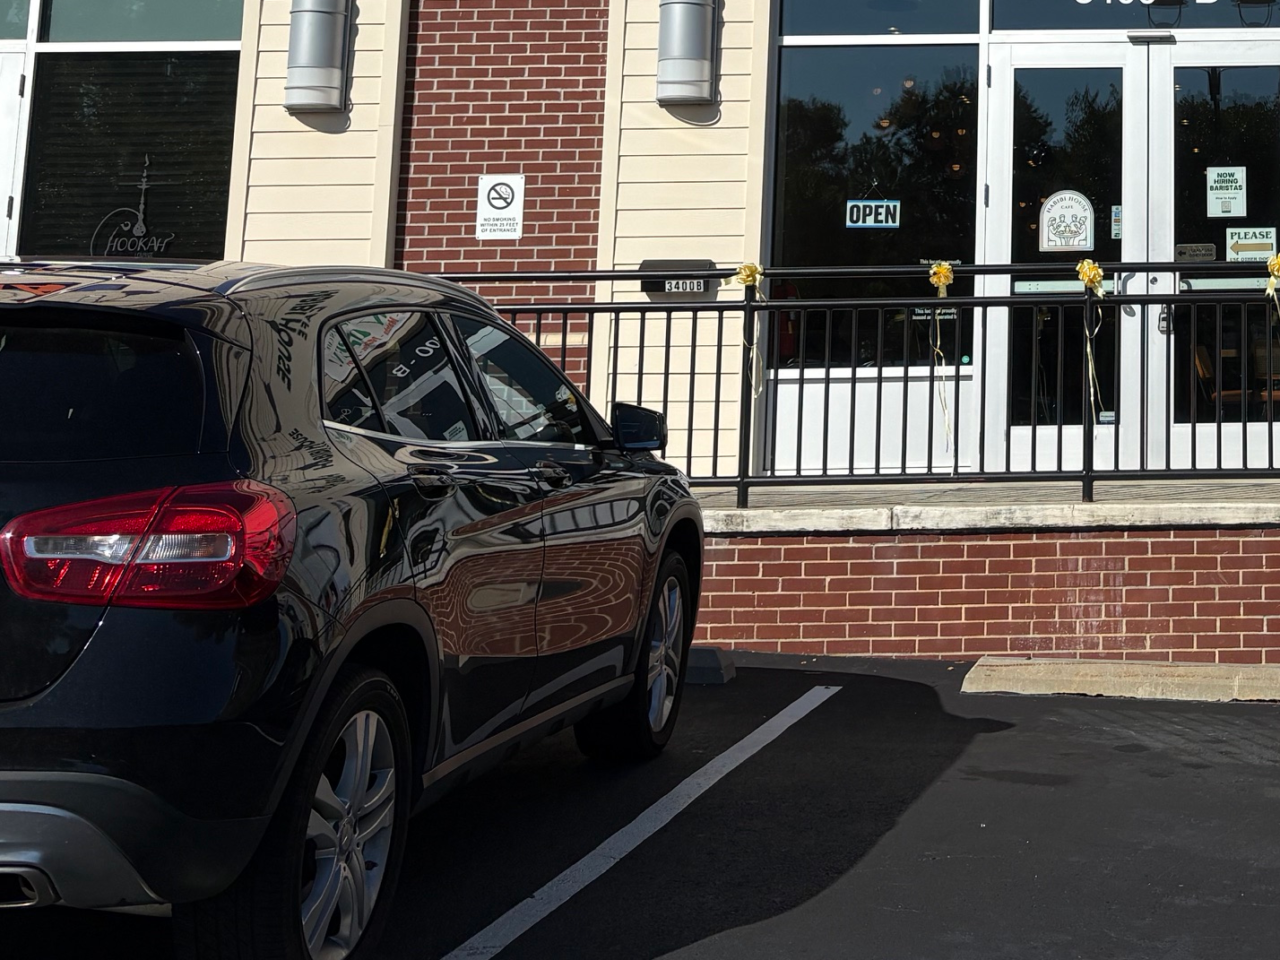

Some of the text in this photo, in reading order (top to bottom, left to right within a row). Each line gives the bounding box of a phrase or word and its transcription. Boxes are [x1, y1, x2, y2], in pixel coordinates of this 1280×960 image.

[1068, 195, 1089, 213] HOUSE
[849, 203, 898, 225] OPEN
[104, 227, 175, 256] HOOKAH
[1230, 230, 1273, 240] PLEASE
[666, 281, 703, 292] 3400B
